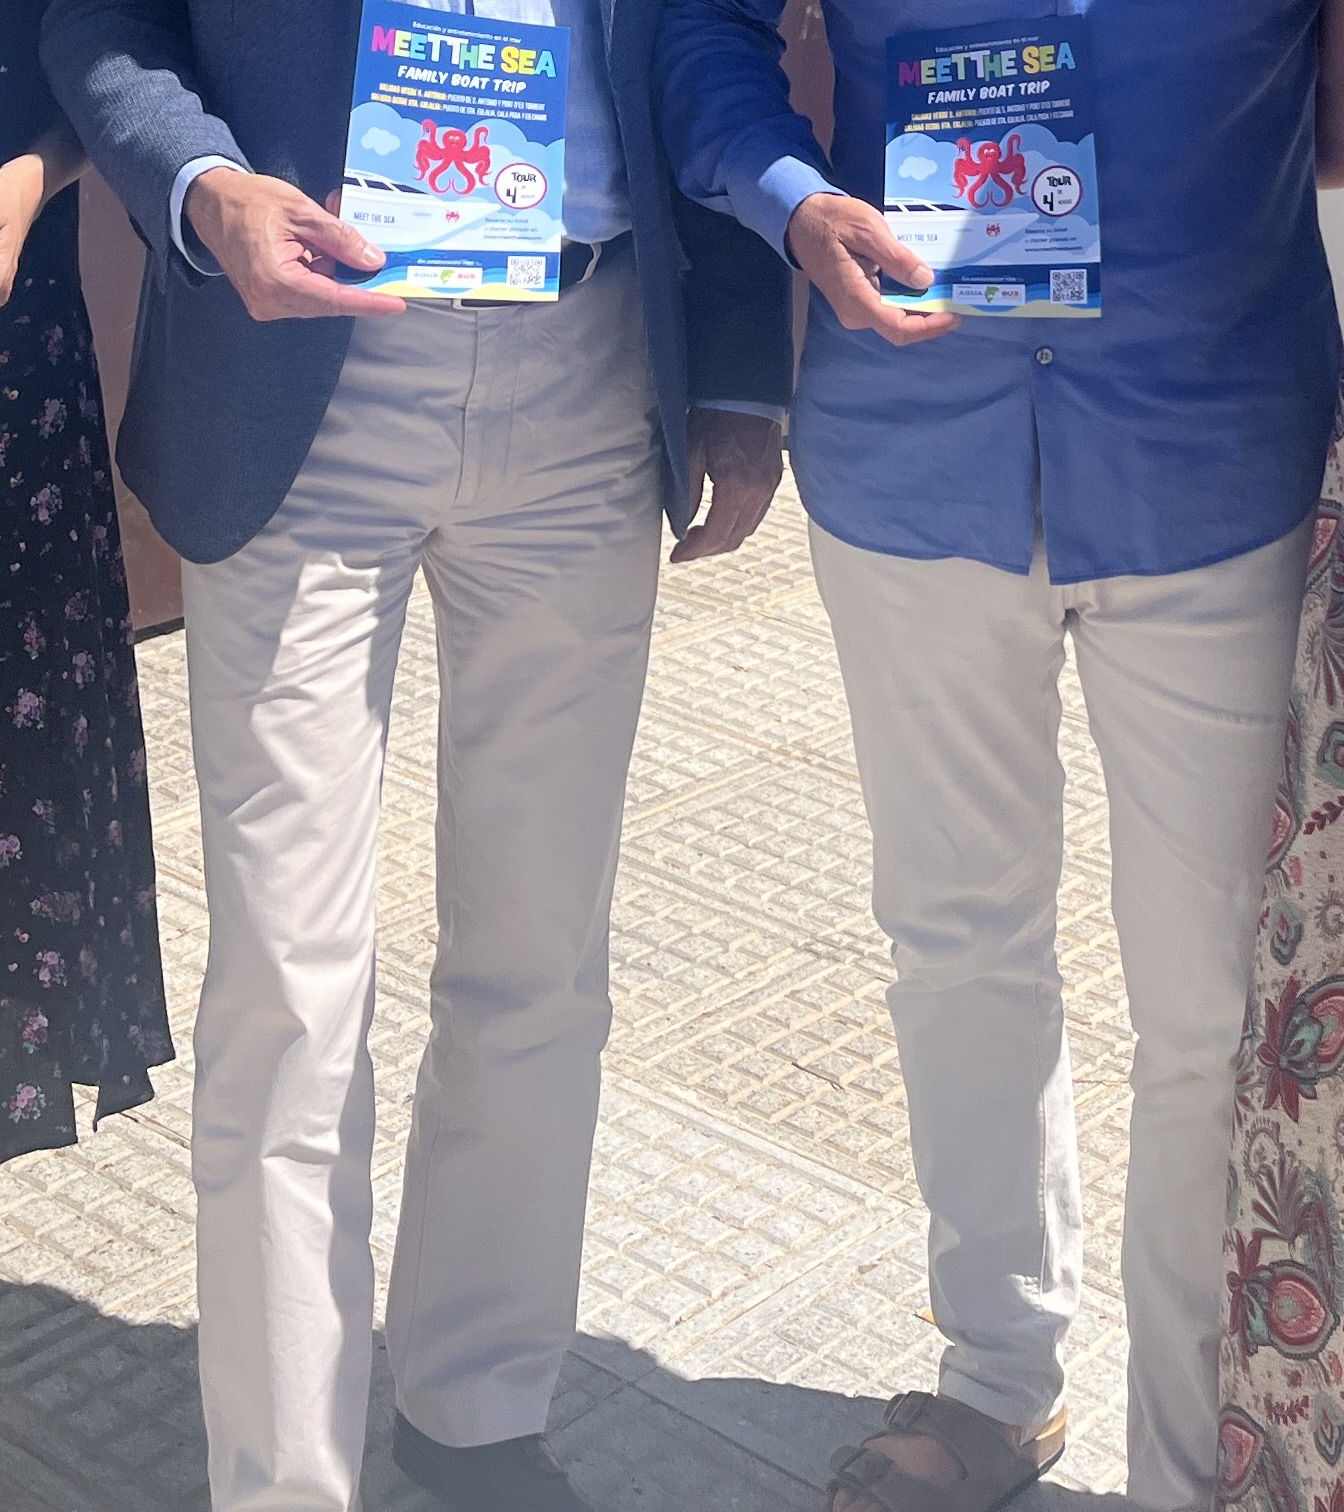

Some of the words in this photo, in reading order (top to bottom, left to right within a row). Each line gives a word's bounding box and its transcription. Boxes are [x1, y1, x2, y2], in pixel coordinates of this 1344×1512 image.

[501, 45, 557, 78] SEA
[1022, 42, 1076, 74] SEA
[397, 65, 449, 85] FAMILY
[451, 73, 490, 89] BOAT
[493, 79, 527, 93] TRIP
[927, 88, 976, 104] FAMILY
[980, 84, 1015, 99] BOAT
[1019, 80, 1051, 95] TRIP
[512, 172, 536, 183] TOUR
[1047, 176, 1072, 187] TOUR
[506, 186, 517, 203] 4
[1043, 192, 1054, 211] 4
[372, 214, 382, 222] THE
[384, 215, 396, 224] SEA
